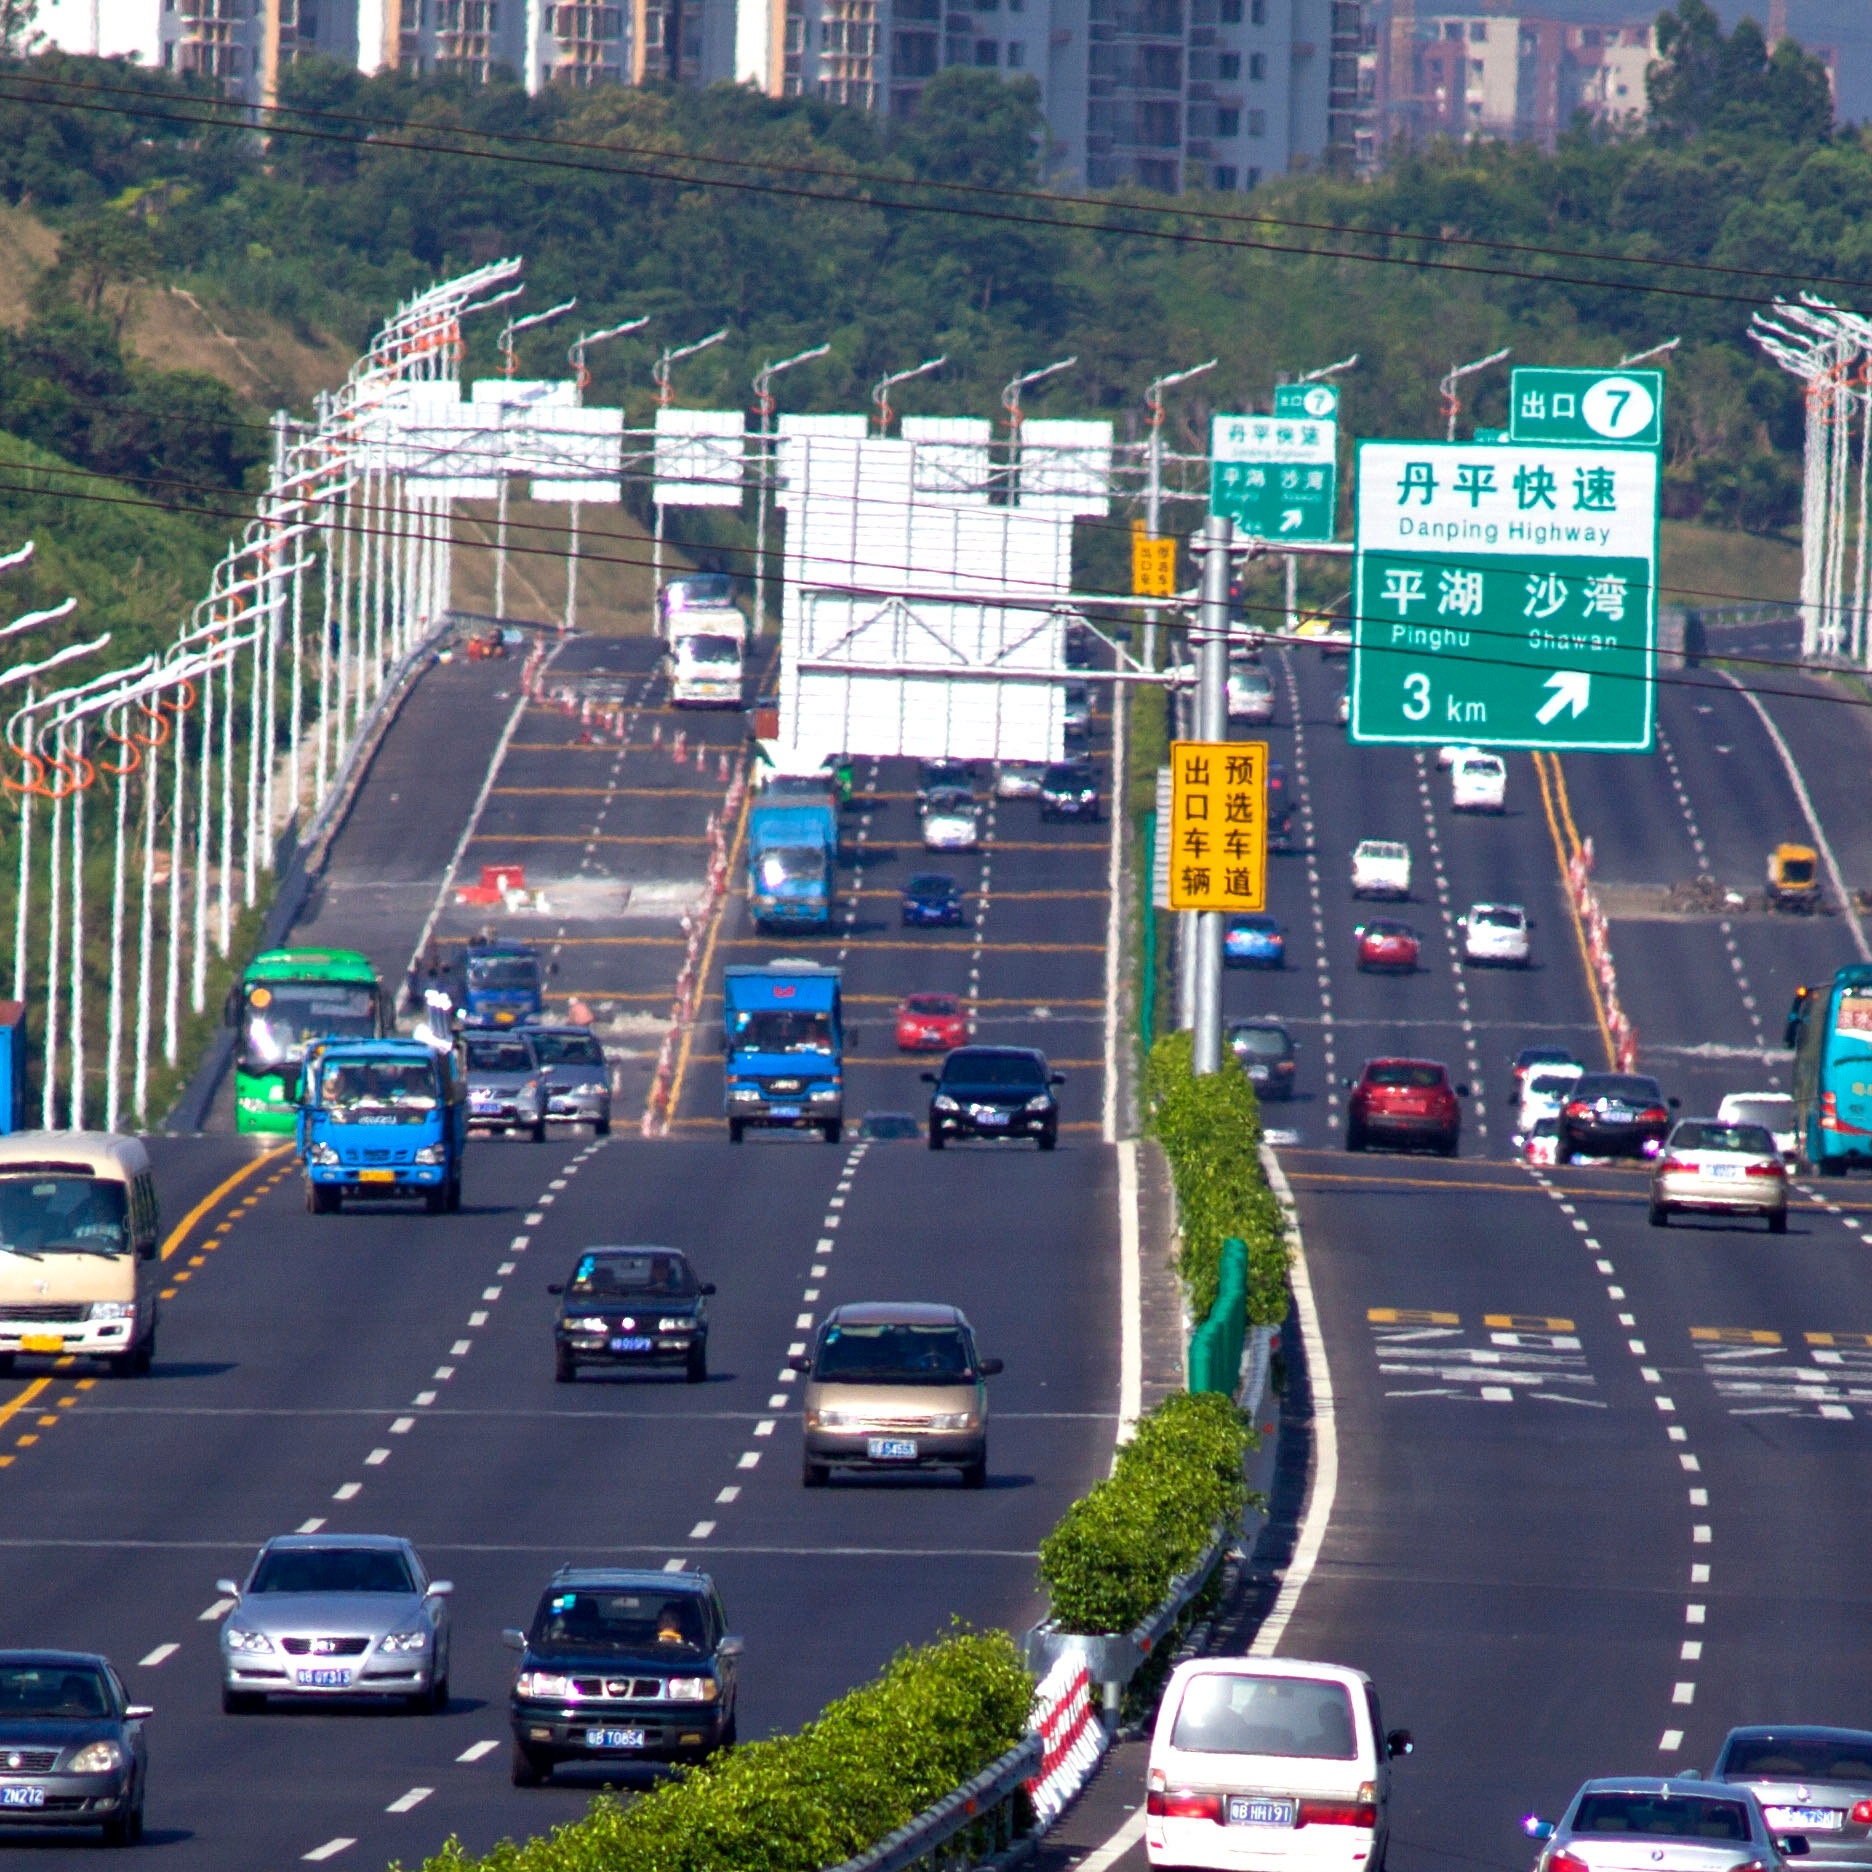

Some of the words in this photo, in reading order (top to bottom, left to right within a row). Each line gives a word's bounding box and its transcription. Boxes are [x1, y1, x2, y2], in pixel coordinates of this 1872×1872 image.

[1521, 390, 1576, 420] 出口
[1606, 391, 1632, 427] 7
[1397, 462, 1617, 512] 丹平快速
[1399, 517, 1498, 544] Danping
[1508, 521, 1610, 545] Highway
[1381, 569, 1484, 618] 平湖
[1523, 573, 1628, 621] 沙湾
[1392, 624, 1470, 650] Pinghu
[1528, 629, 1618, 650] Shawan
[1402, 673, 1431, 720] 3
[1447, 695, 1486, 722] km
[1182, 756, 1211, 896] 出口车辆
[1224, 756, 1254, 896] 预选车道
